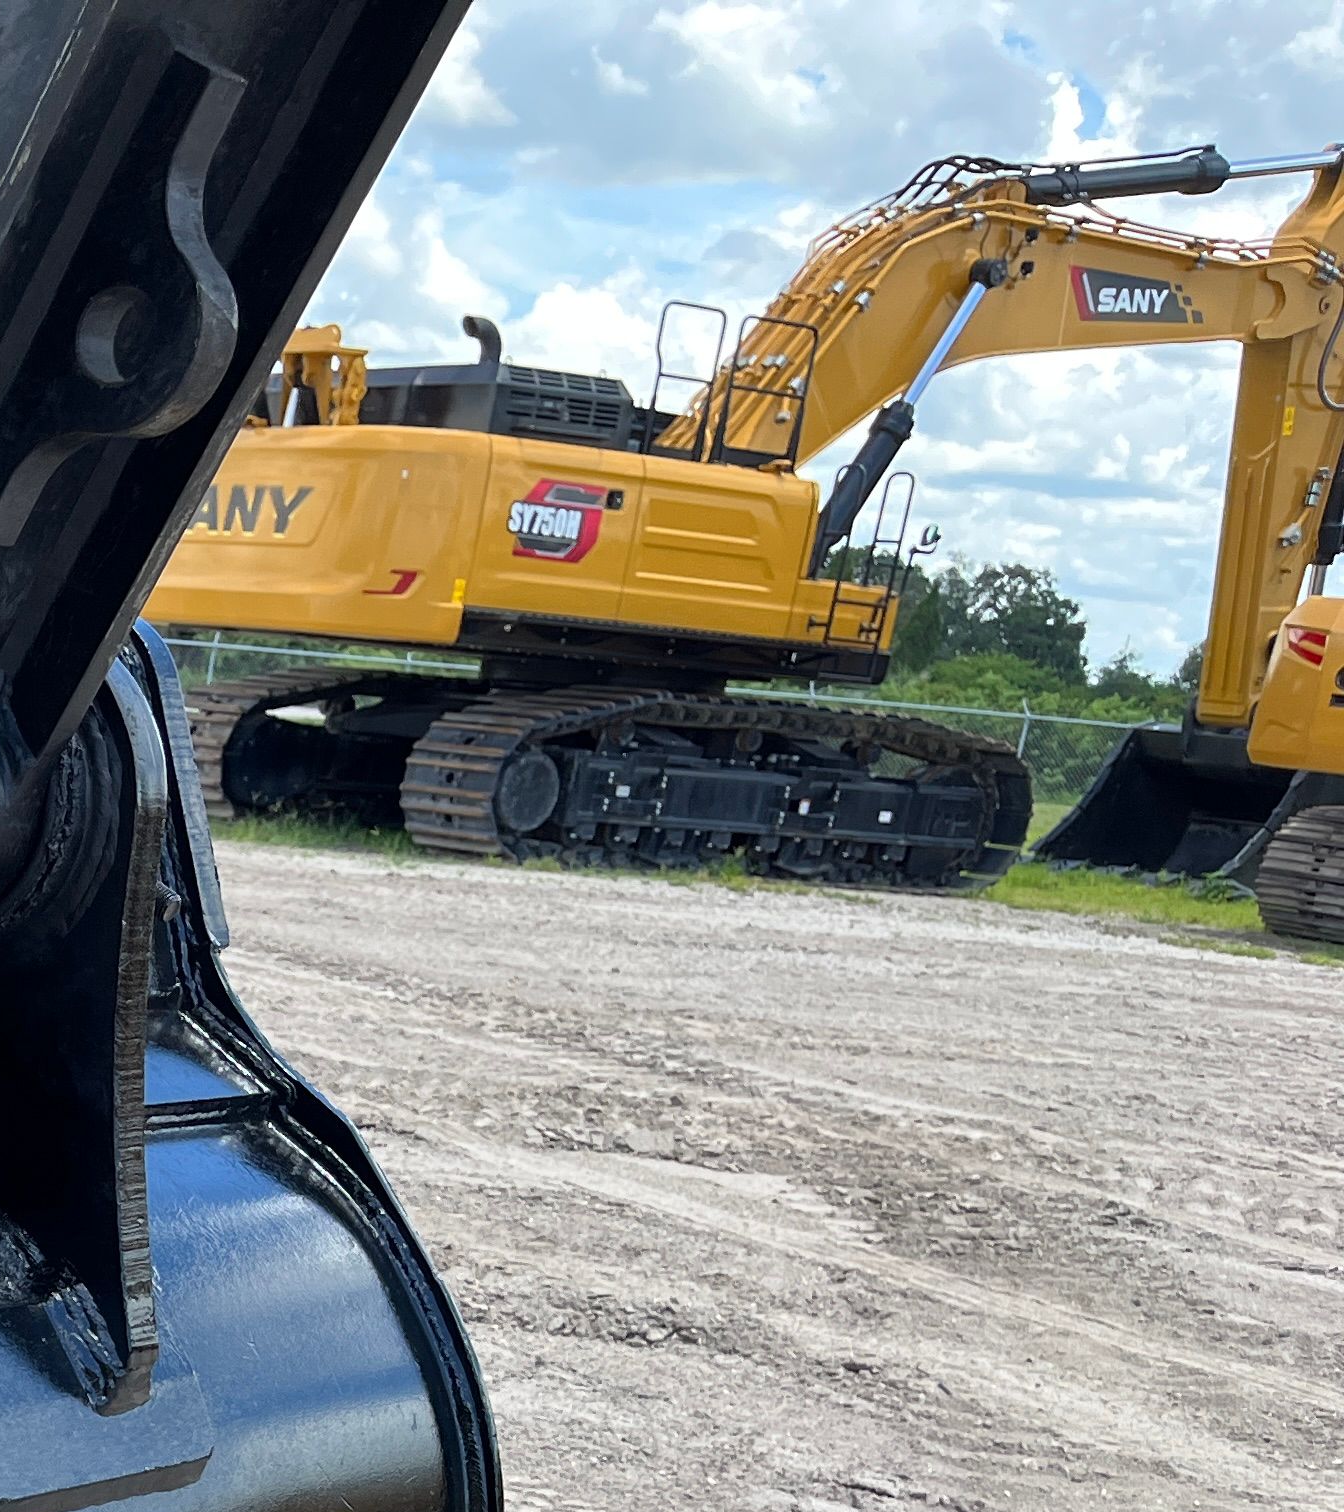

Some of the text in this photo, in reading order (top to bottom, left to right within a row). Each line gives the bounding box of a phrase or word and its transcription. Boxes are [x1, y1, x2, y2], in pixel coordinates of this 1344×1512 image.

[1097, 287, 1169, 314] SANY
[185, 484, 315, 536] ANY
[508, 501, 583, 540] SY750H
